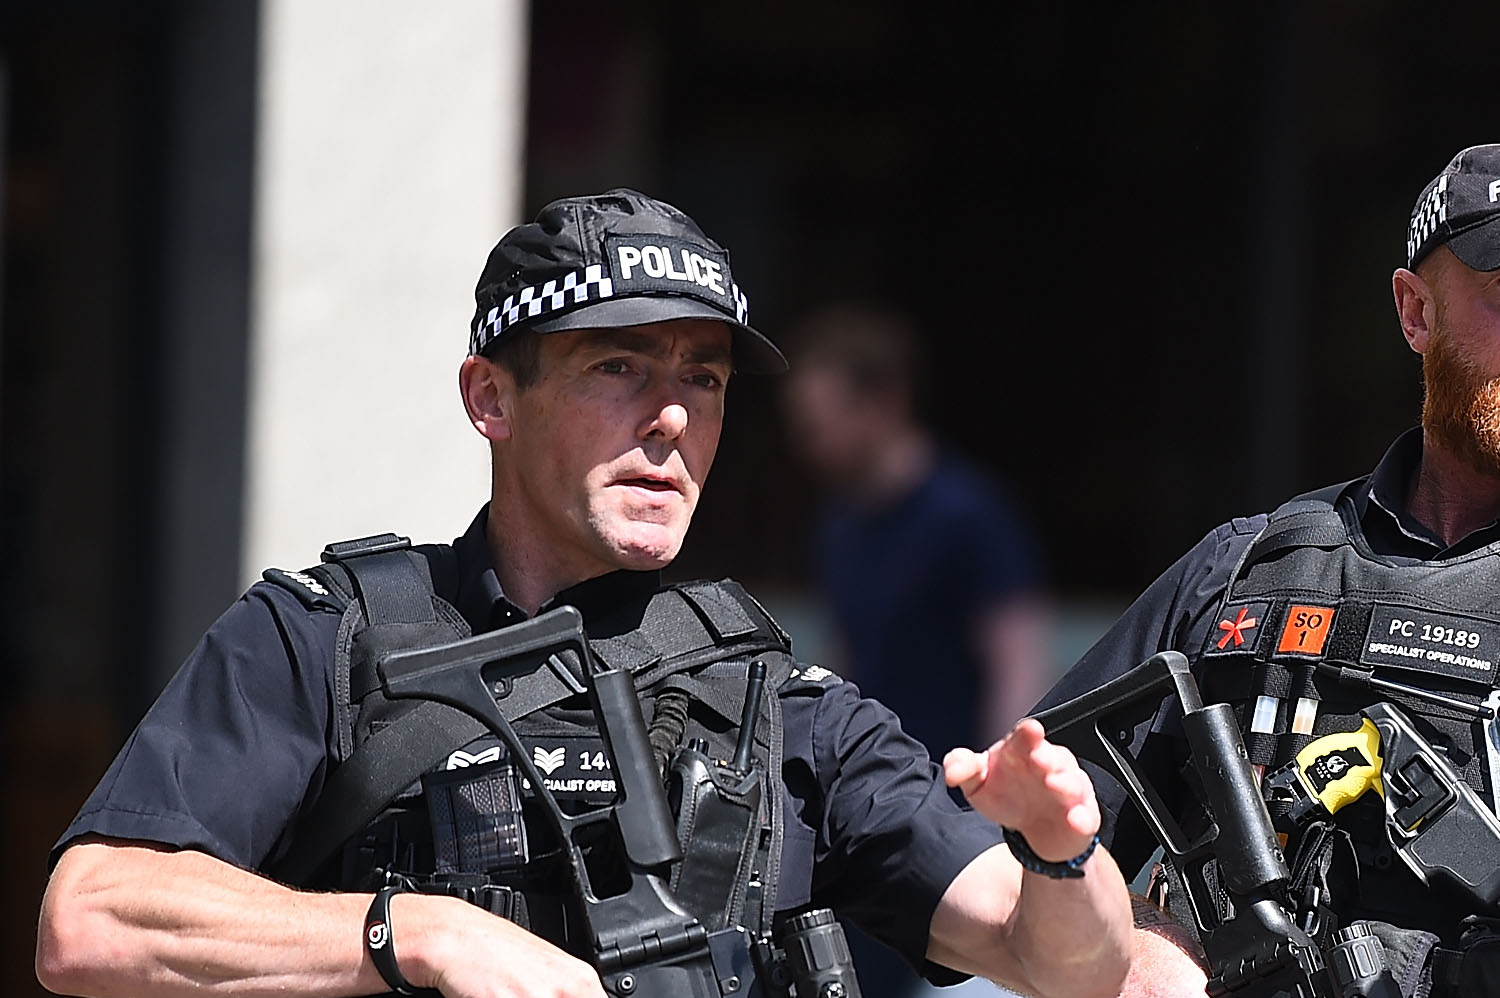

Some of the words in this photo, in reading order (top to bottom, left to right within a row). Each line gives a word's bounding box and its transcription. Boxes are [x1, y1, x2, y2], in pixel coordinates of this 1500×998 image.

[617, 245, 726, 296] POLICE
[1294, 612, 1323, 629] SO
[1298, 630, 1307, 646] 1
[1388, 619, 1415, 637] PC
[1420, 624, 1481, 649] 19189
[1368, 642, 1427, 659] SPECIALIST
[1426, 650, 1492, 671] OPERATIONS
[579, 751, 611, 771] 14
